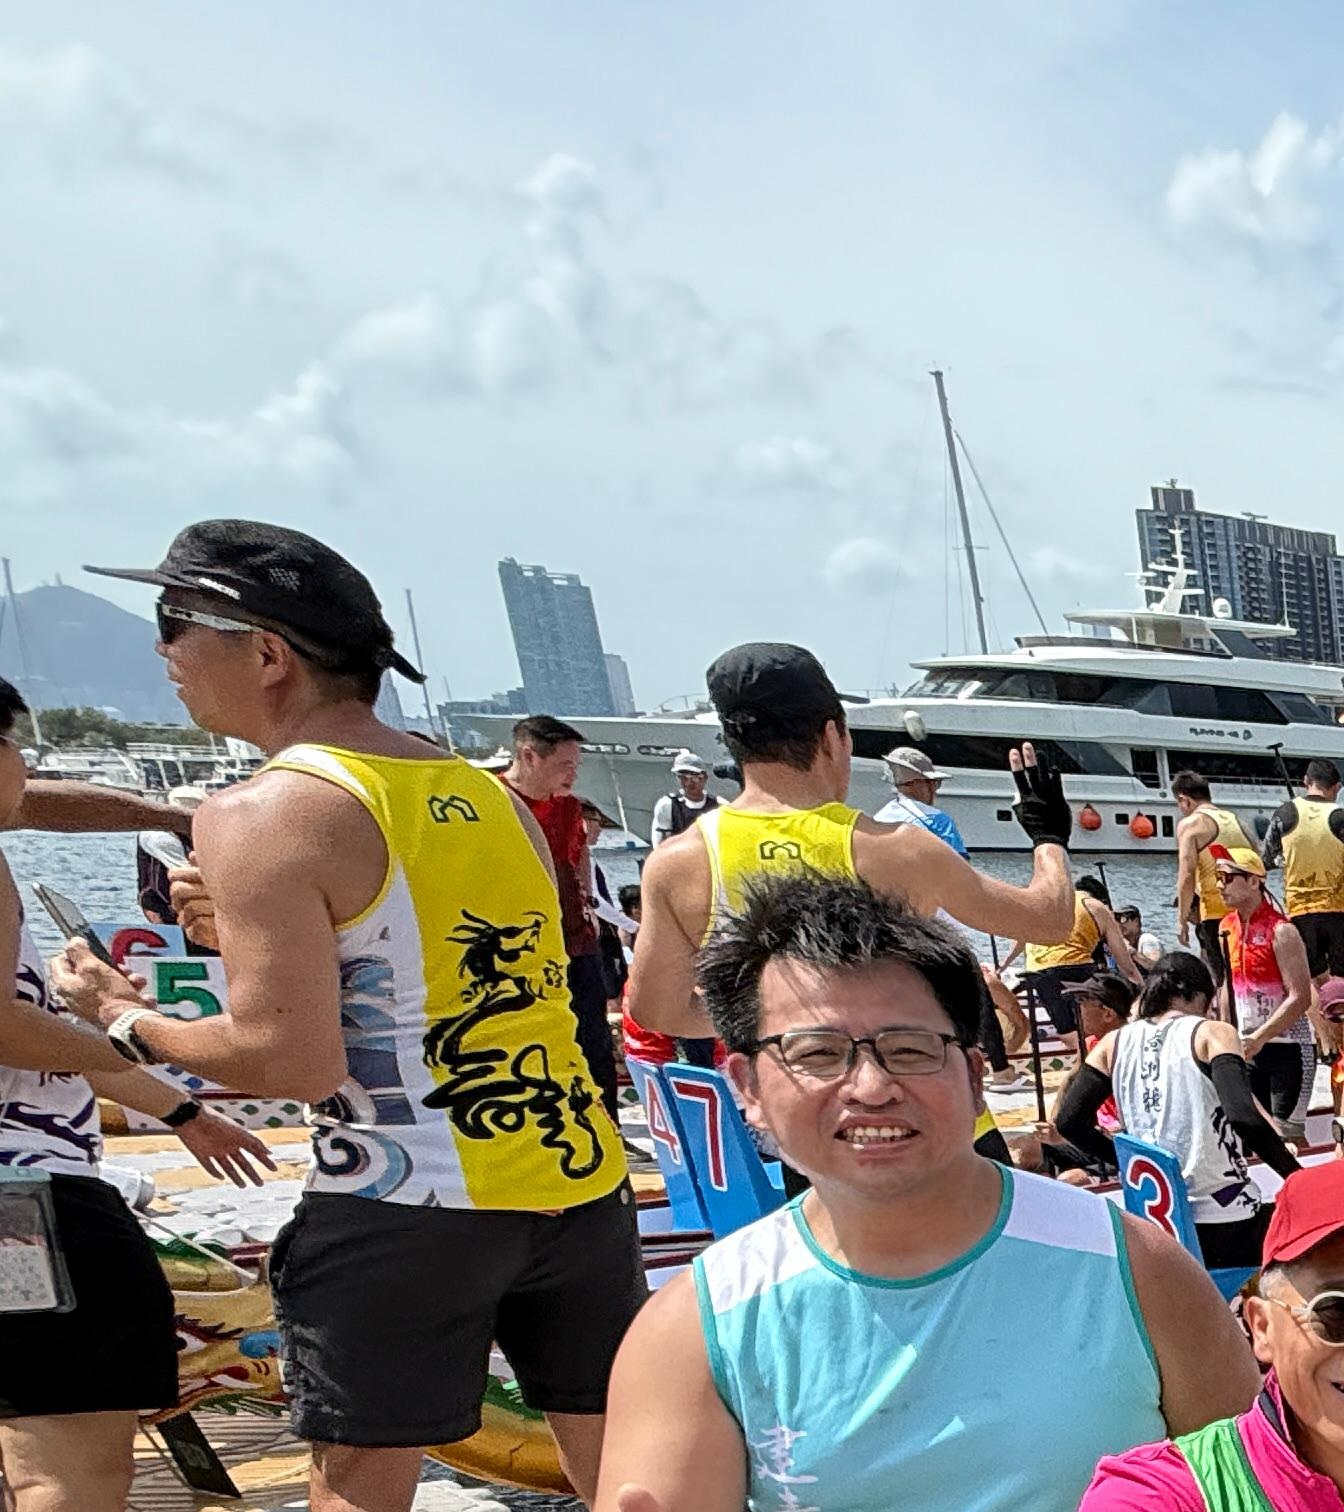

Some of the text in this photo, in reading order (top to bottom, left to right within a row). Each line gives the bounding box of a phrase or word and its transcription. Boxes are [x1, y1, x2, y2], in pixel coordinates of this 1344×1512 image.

[153, 961, 224, 1020] 5
[644, 1074, 682, 1165] 4
[669, 1076, 728, 1192] 7
[1126, 1155, 1179, 1242] 3
